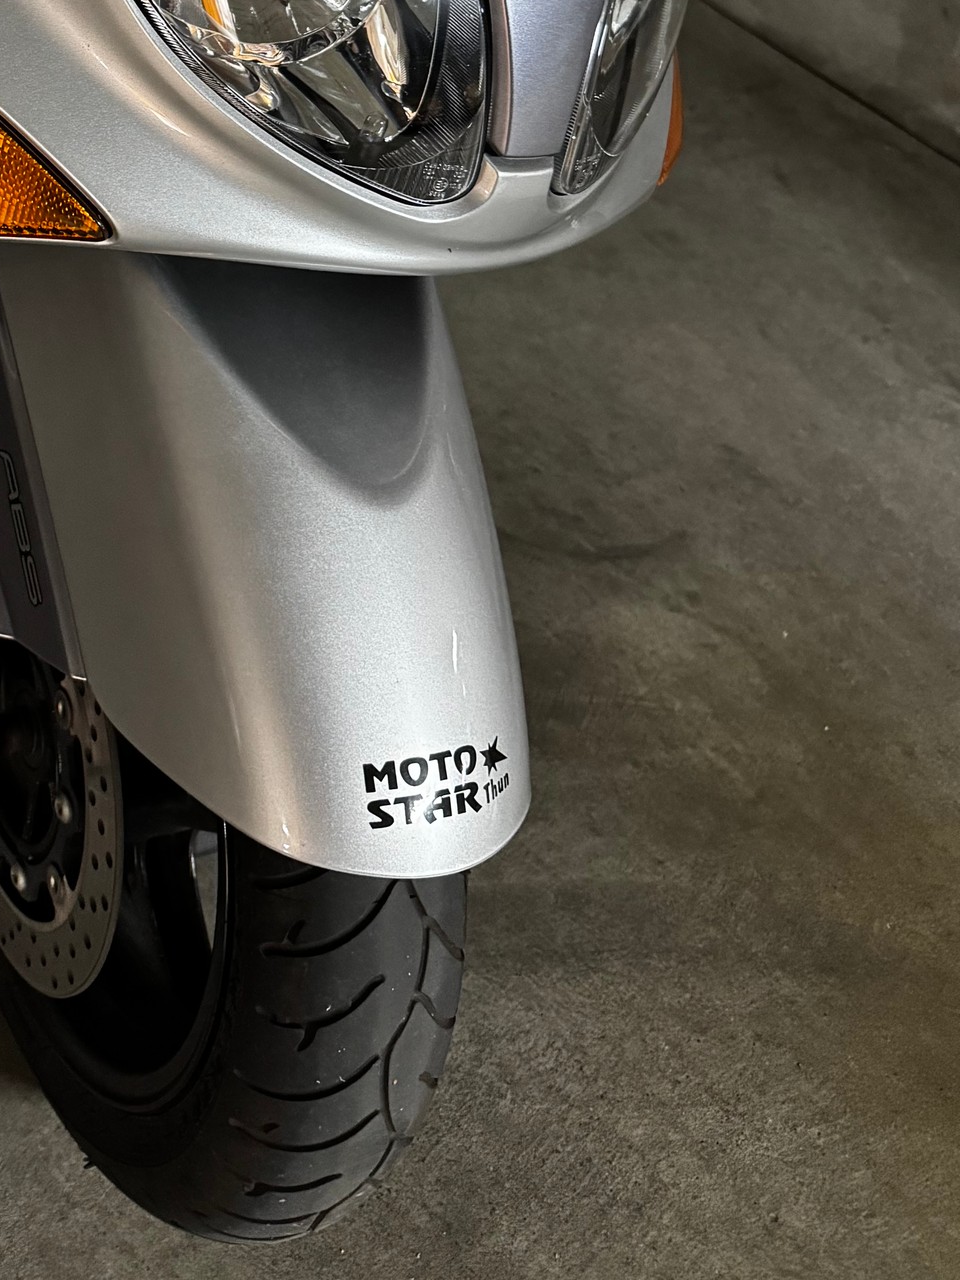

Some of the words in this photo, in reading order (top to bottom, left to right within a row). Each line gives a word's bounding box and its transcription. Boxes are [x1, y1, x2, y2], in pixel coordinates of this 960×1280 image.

[362, 744, 477, 793] MOTO
[366, 781, 483, 829] STAR
[483, 772, 510, 804] Thun
